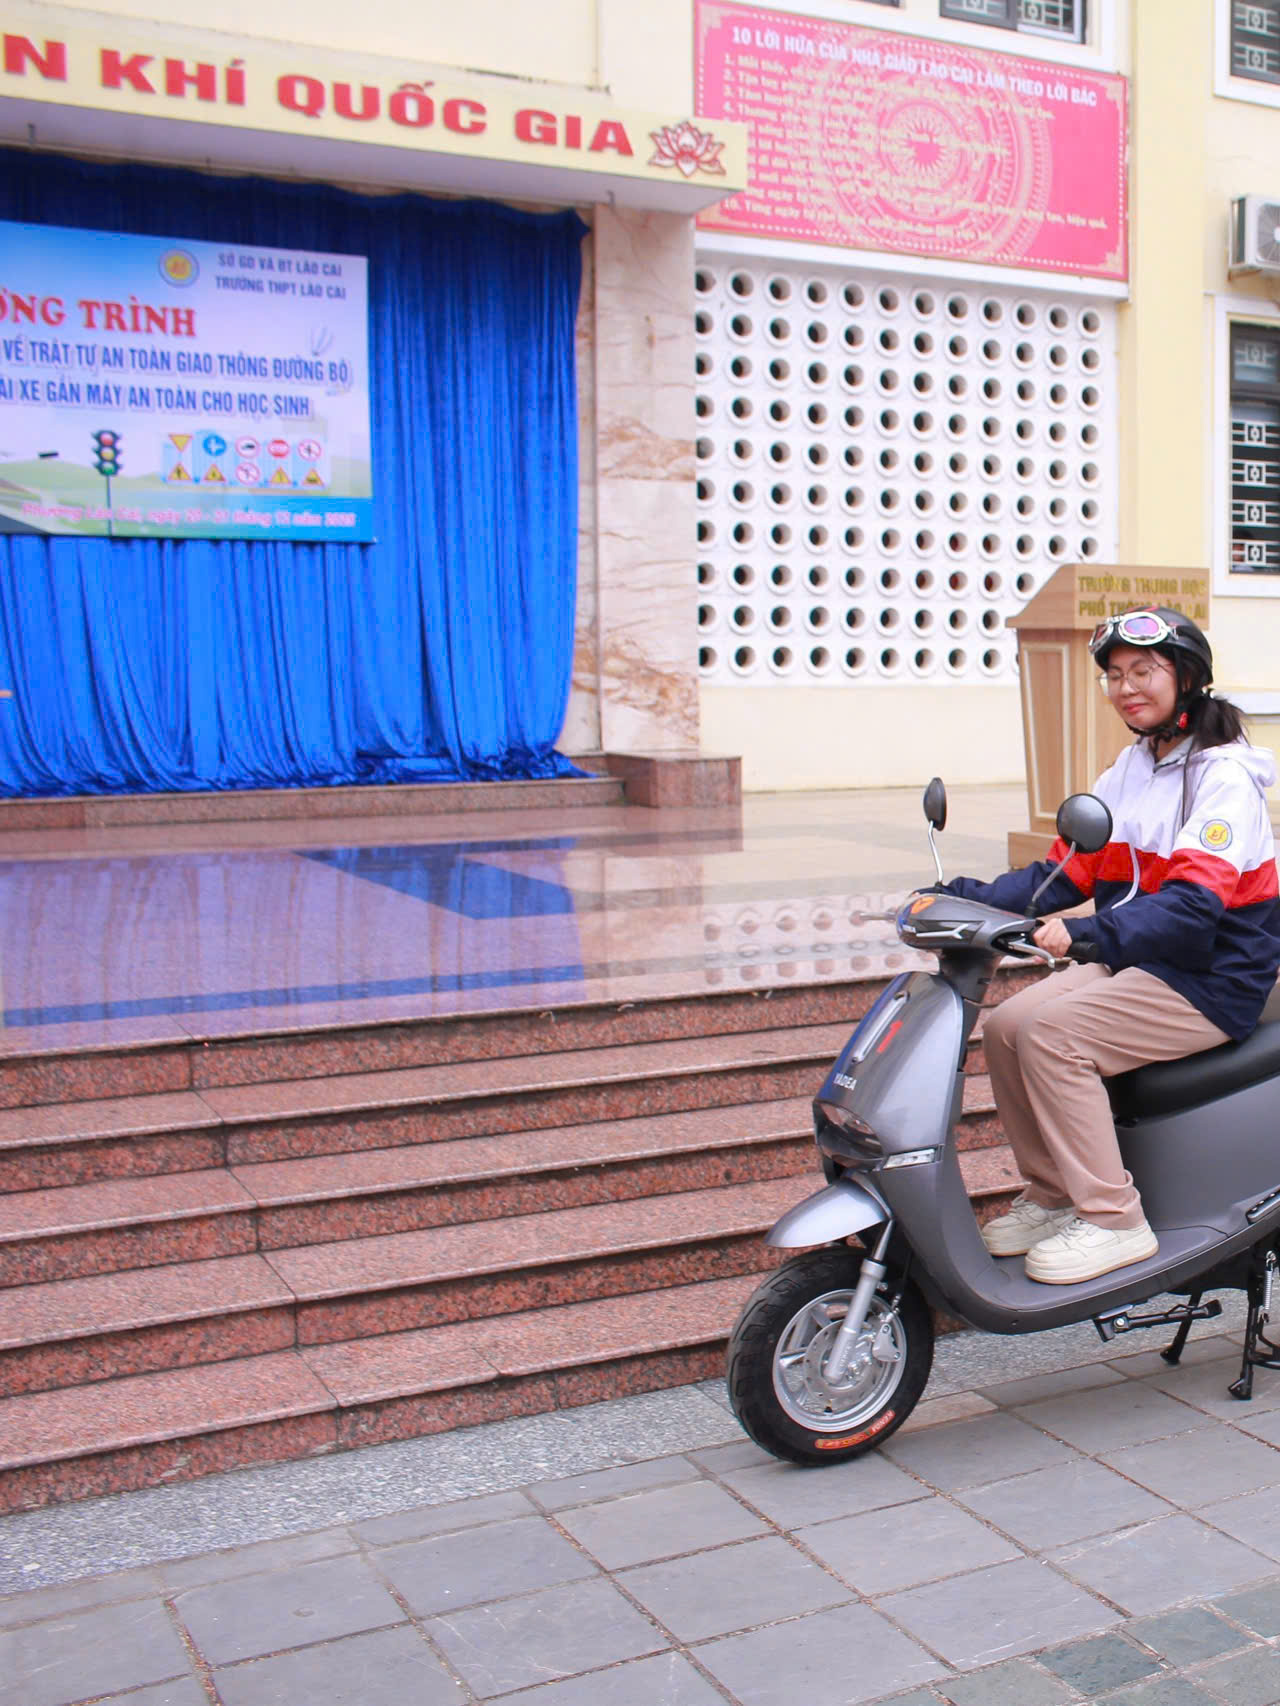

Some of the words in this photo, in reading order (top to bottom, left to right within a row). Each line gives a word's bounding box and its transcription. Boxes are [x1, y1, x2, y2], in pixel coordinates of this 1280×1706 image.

[733, 26, 750, 45] 10
[755, 29, 780, 50] LỜI
[950, 65, 973, 84] CAI
[1009, 76, 1043, 96] THEO
[1047, 81, 1067, 102] LỜI
[1071, 86, 1097, 107] BÁC
[3, 33, 67, 82] N
[99, 48, 246, 107] KHÍ
[277, 74, 487, 135] QUỐC
[514, 108, 634, 157] GIA
[322, 263, 342, 277] CAI
[268, 281, 296, 296] THPT
[326, 286, 346, 300] CAI
[77, 295, 196, 337] TRÌNH
[102, 347, 124, 368] AN
[129, 345, 171, 371] TOÀN
[177, 351, 213, 375] GIAO
[217, 351, 268, 378] THÔNG
[273, 355, 324, 381] ĐƯỜNG
[19, 379, 40, 401] XE
[128, 386, 150, 408] AN
[155, 384, 197, 410] TOÀN
[202, 389, 233, 413] CHO
[274, 395, 310, 417] SINH
